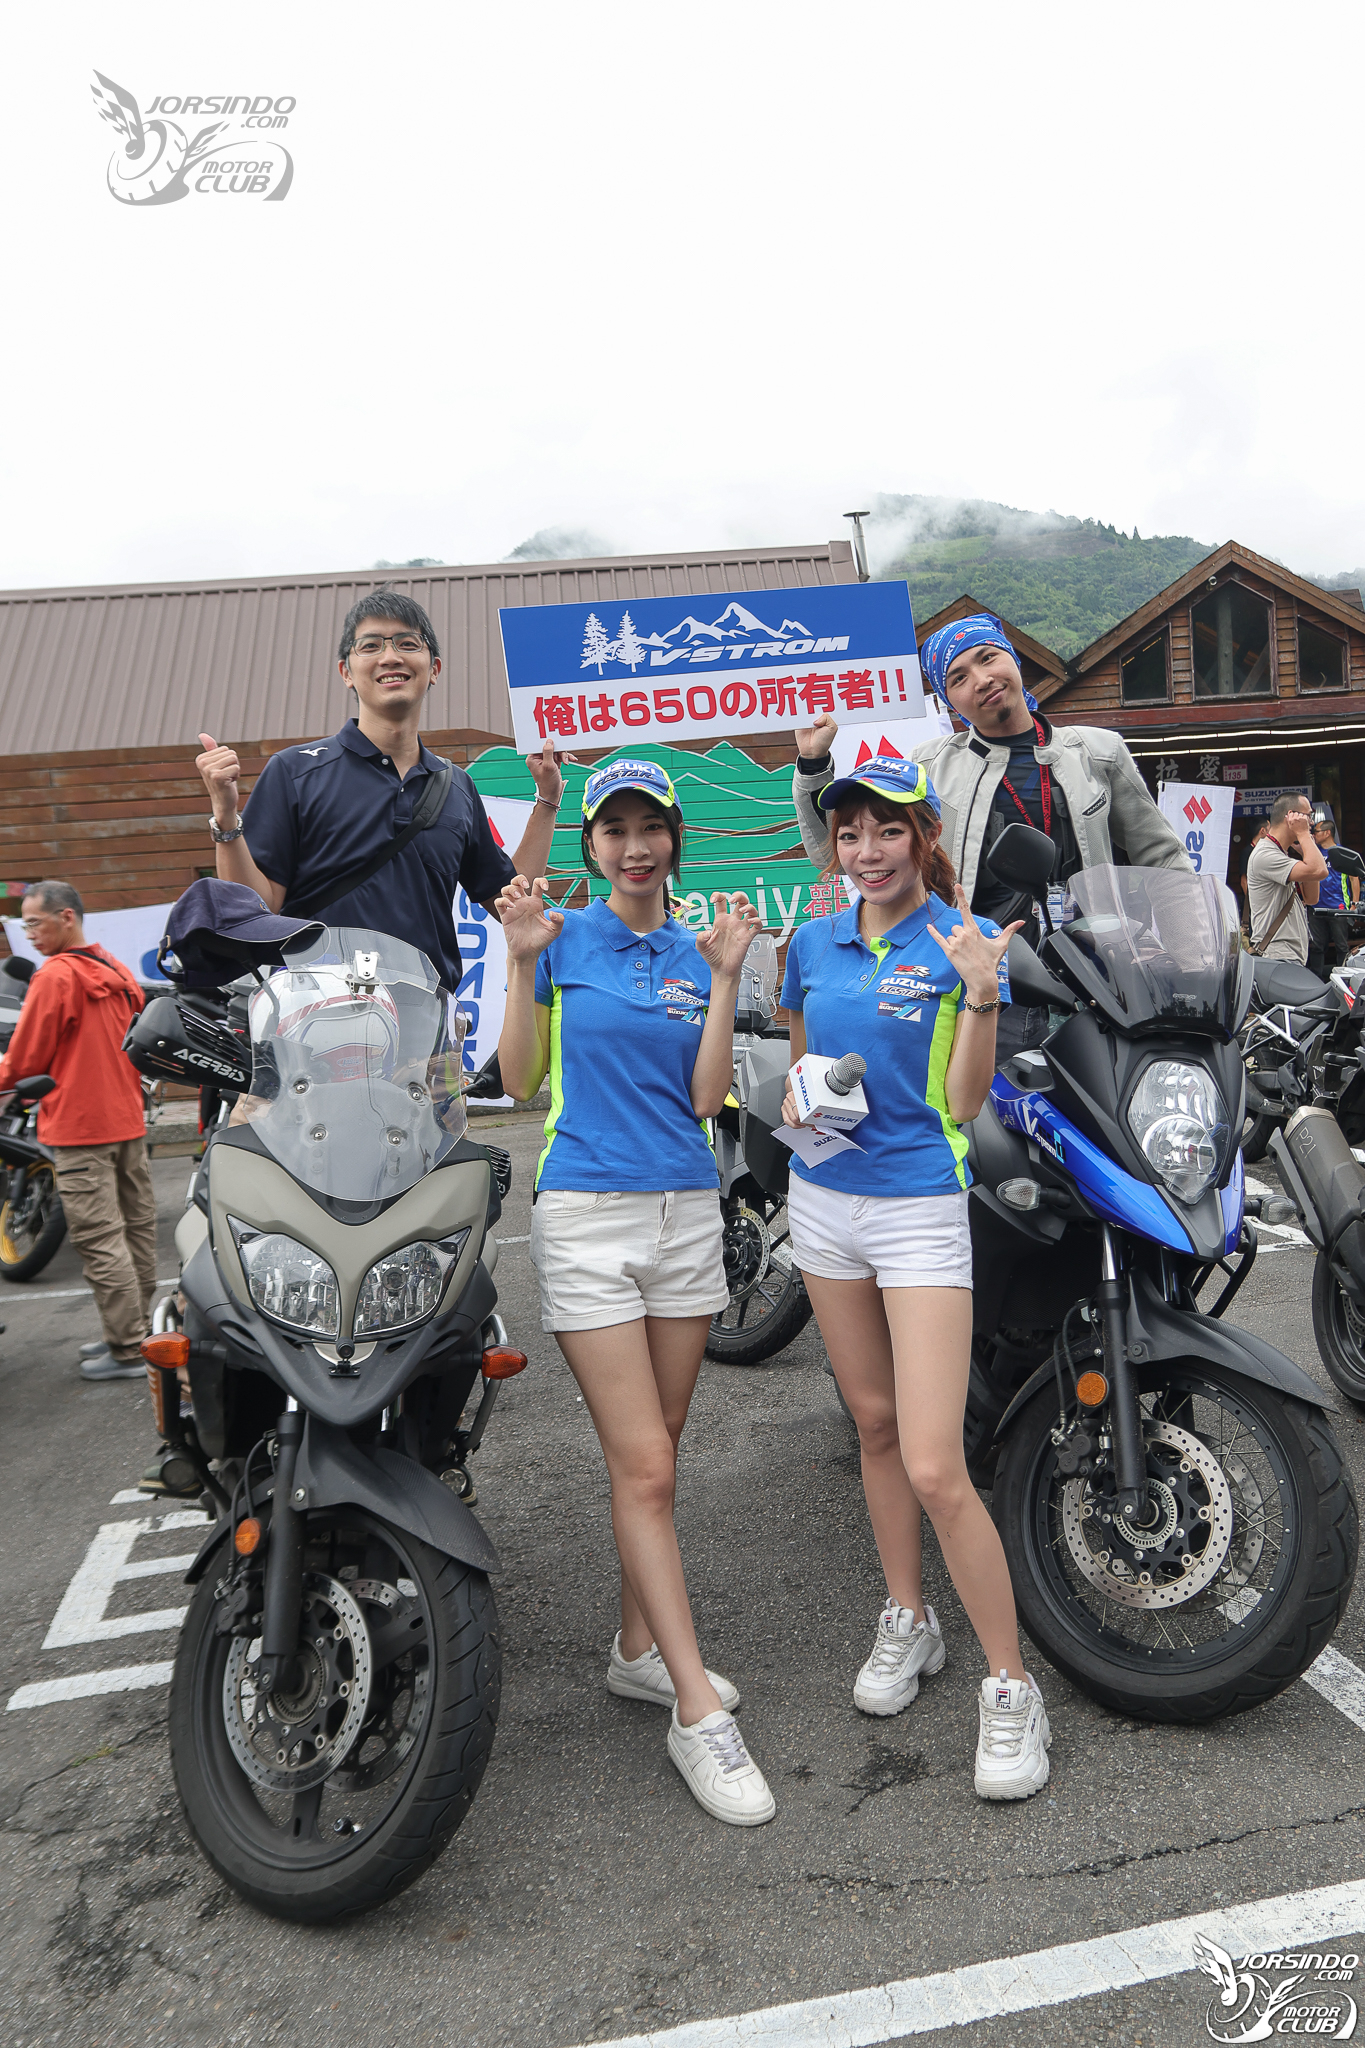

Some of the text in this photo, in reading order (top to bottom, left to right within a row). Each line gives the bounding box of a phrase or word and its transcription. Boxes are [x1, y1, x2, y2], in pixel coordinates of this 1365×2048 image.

[649, 635, 850, 667] V-STROM
[533, 668, 907, 739] 俺は650の所有者!!
[591, 762, 656, 786] SUZUKI
[1228, 771, 1241, 779] 135
[1244, 789, 1281, 798] SUZUKI
[455, 886, 488, 1072] SUZUK
[880, 977, 937, 993] SUZUKI
[172, 1048, 246, 1083] ACERBIS
[799, 1075, 811, 1112] SUZUKI
[823, 1114, 859, 1123] SUZUKI
[813, 1135, 839, 1147] SUZU
